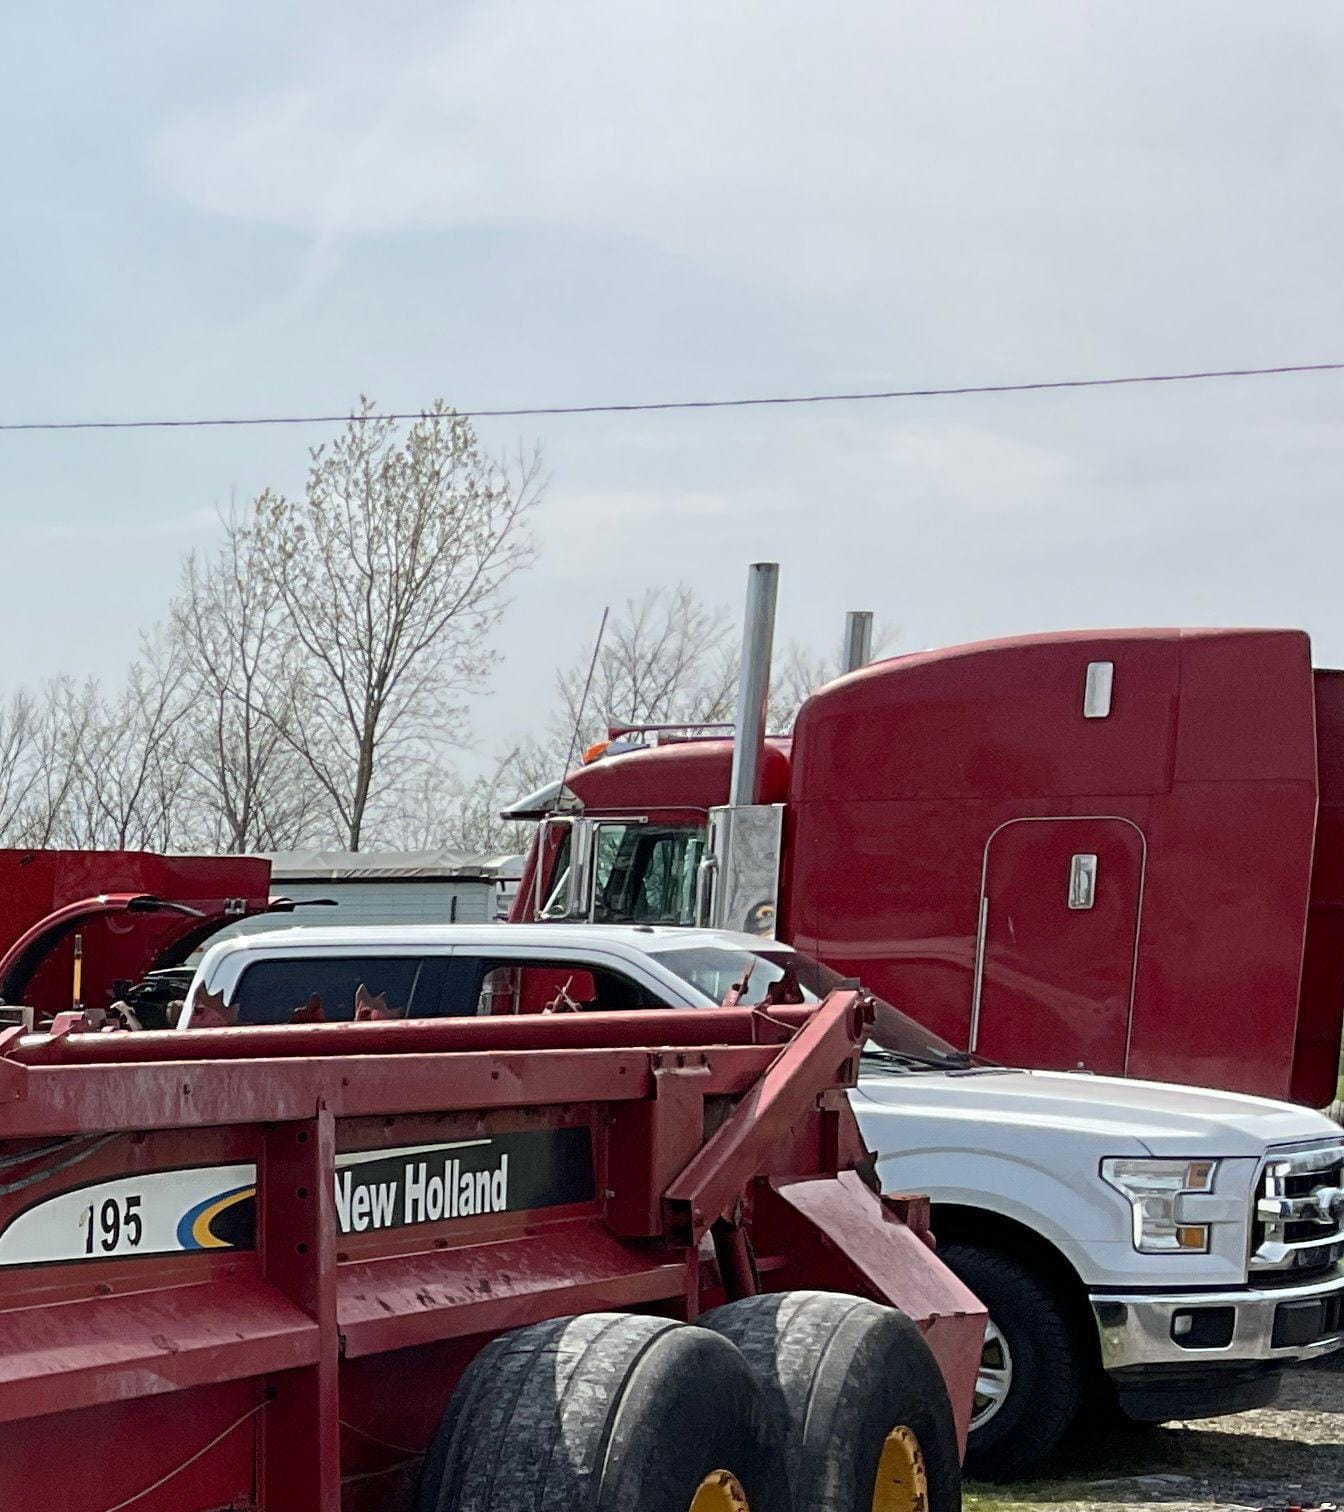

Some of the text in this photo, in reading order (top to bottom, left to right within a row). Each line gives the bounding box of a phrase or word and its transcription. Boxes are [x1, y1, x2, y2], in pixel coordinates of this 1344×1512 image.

[82, 1195, 143, 1254] 195
[334, 1153, 509, 1233] New Holland
